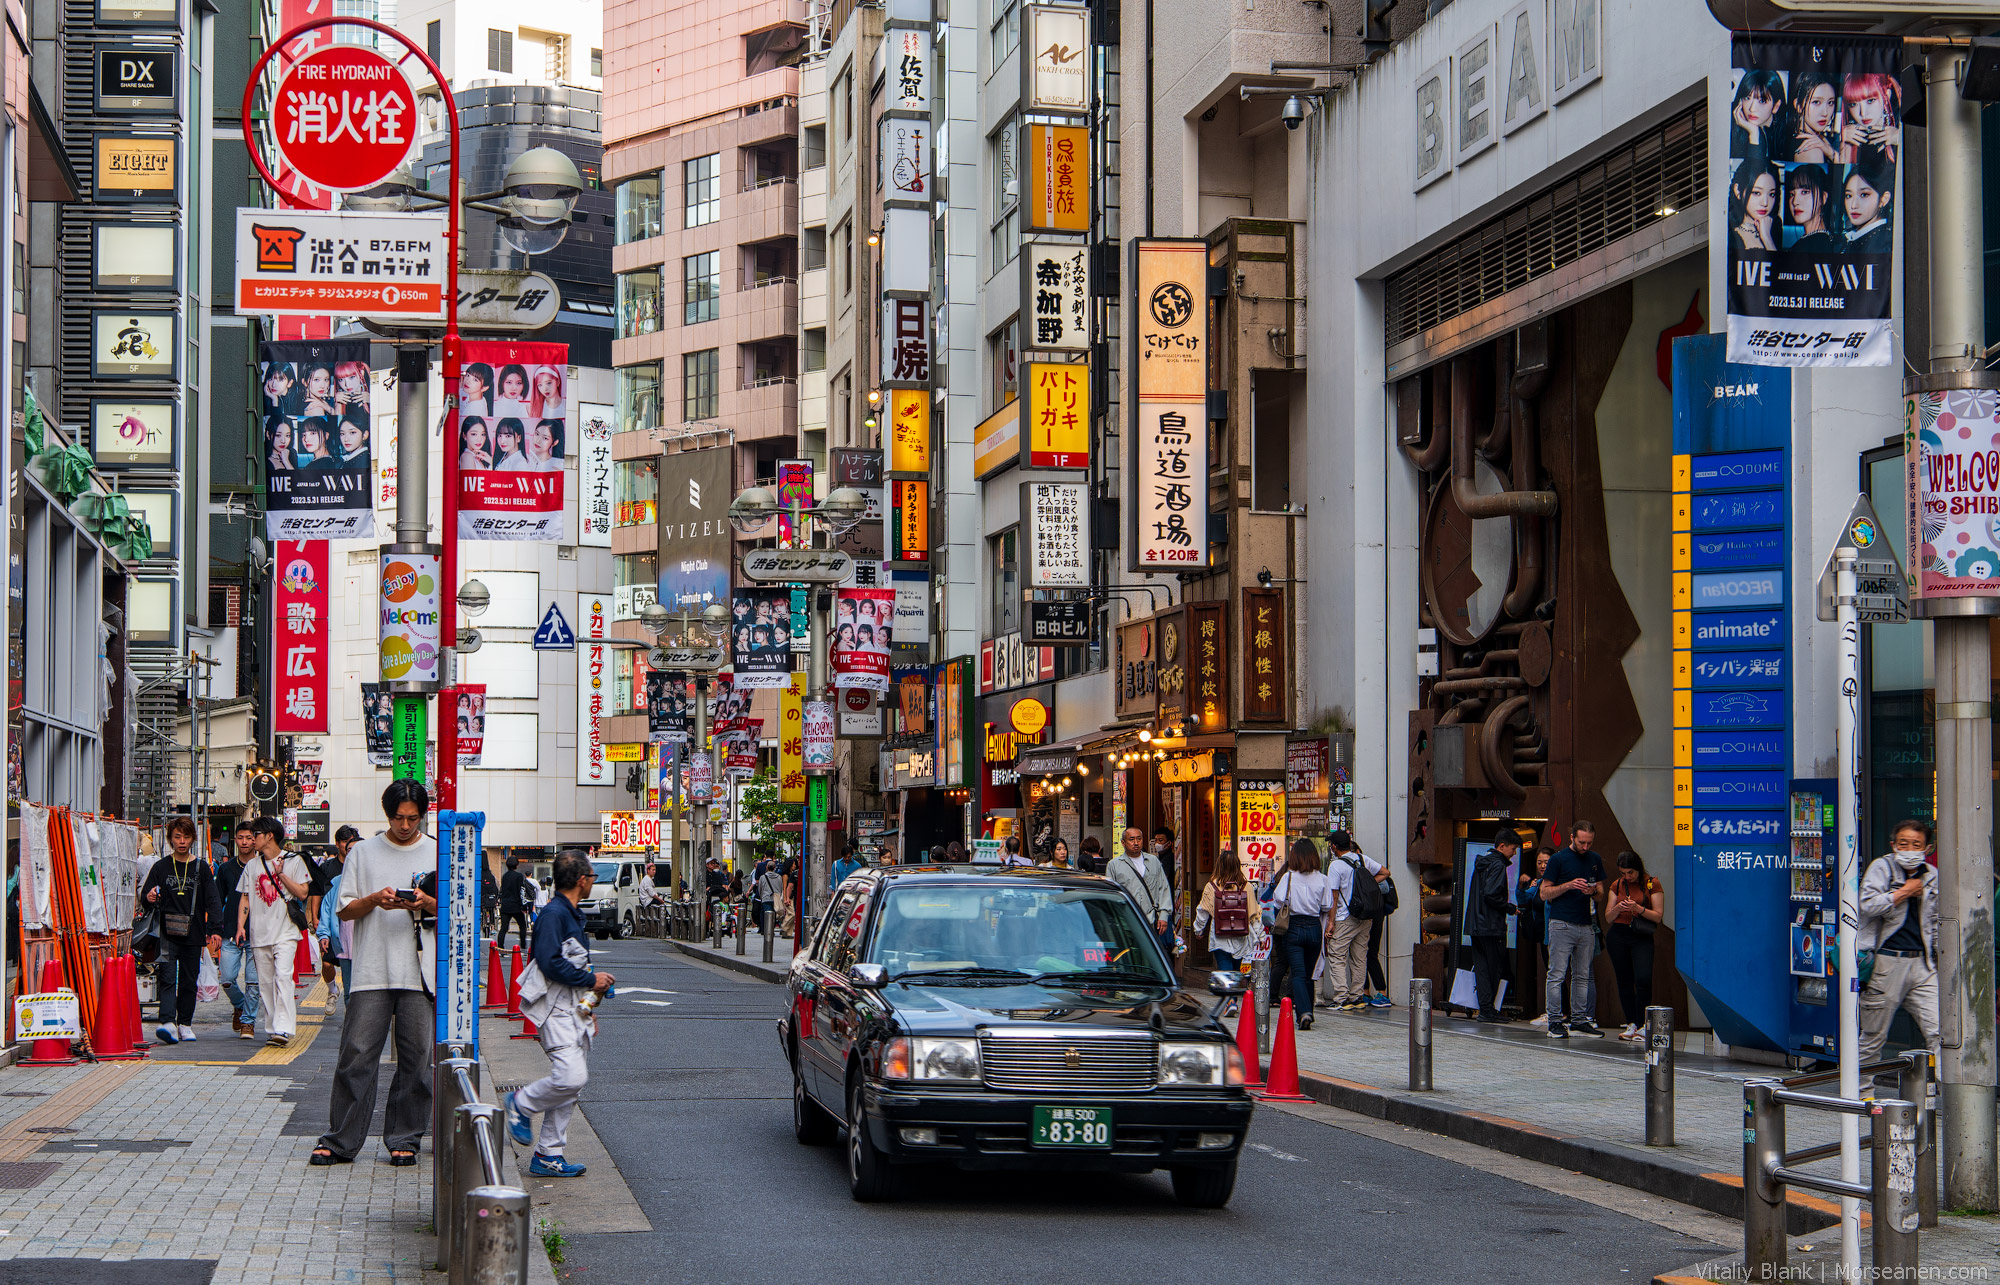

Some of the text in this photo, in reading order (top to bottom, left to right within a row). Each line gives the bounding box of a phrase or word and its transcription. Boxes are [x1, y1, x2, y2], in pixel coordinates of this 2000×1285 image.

[133, 11, 142, 19] 9F
[120, 61, 154, 82] DX
[298, 65, 393, 81] FIRE HYDRANT
[898, 54, 925, 101] 佐賀
[1059, 67, 1085, 75] CROSS
[1416, 0, 1596, 180] BEAM
[132, 99, 142, 107] 8F
[287, 90, 407, 145] 消火栓
[109, 153, 168, 171] EIGHT
[1056, 138, 1075, 215] 鳥貴族
[370, 240, 432, 252] 87.6FM
[310, 239, 432, 276] 渋谷のラジオ
[131, 276, 141, 284] 6F
[1063, 261, 1072, 289] なかの
[1737, 260, 1772, 287] IVE
[255, 286, 288, 298] ヒカリエ
[289, 286, 316, 298] デッキ
[401, 289, 429, 300] 650m
[1036, 258, 1064, 345] 奈加野
[1769, 296, 1845, 309] 2023.5.31 RELEASE
[893, 300, 929, 380] 日焼
[1144, 333, 1200, 350] てけてけ
[1747, 329, 1867, 348] 渋谷センター街
[1714, 383, 1759, 398] BEAM
[1061, 371, 1079, 431] トリキ
[1040, 371, 1059, 448] バーガー
[1053, 454, 1069, 466] 1F
[849, 468, 874, 480] ビル
[1152, 411, 1192, 546] 鳥道酒場
[271, 476, 291, 492] IVE
[464, 476, 485, 492] IVE
[592, 446, 610, 534] サウナ道場
[1037, 484, 1078, 497] 地下だけ
[291, 495, 345, 505] 2023.5.31 RELEASE
[484, 497, 537, 506] 2023.5.31 RELEASE
[1925, 496, 2000, 515] TO SHIB
[1037, 506, 1078, 515] 雰囲気良く
[1731, 500, 1776, 517] 鍋ぞう
[280, 516, 359, 529] 渋谷センター街
[472, 518, 549, 530] 渋谷センター街
[1037, 515, 1079, 523] て料理人が
[665, 519, 725, 540] VIZEL
[1037, 524, 1079, 532] しっかり食
[1037, 532, 1079, 541] 事を作って
[1038, 541, 1079, 550] お酒もたく
[1038, 550, 1079, 558] さんあって
[1145, 549, 1199, 561] 全120席
[681, 560, 708, 573] Night Club
[750, 558, 847, 571] 渋谷センター街
[1038, 558, 1083, 568] 楽しいお店。
[383, 571, 415, 597] Enjoy
[1926, 583, 1975, 591] SHIBUYA
[380, 607, 438, 625] Welcome
[895, 608, 925, 617] Aquavit
[1035, 620, 1087, 637] 田中ビル
[286, 601, 316, 720] 歌広場
[399, 650, 420, 664] Lovely
[737, 654, 749, 663] IVE
[840, 655, 851, 664] IVE
[1254, 606, 1273, 702] ど根性串
[1200, 619, 1217, 716] 博多水炊き
[1696, 658, 1781, 677] イシバシ楽器
[848, 696, 868, 705] ガスト
[590, 693, 604, 780] まねきねこ
[804, 721, 833, 736] WELCOME
[404, 702, 418, 779] 客引きは犯罪です
[1748, 743, 1781, 752] HALL
[1748, 782, 1781, 792] HALL
[1240, 801, 1271, 811] 生ビール
[1241, 811, 1276, 832] 180
[1710, 819, 1780, 834] まんだらけ
[611, 820, 629, 845] 50
[629, 822, 637, 844] 生中
[637, 819, 660, 846] 190
[1247, 842, 1277, 861] 99
[1717, 851, 1788, 869] 銀行ATM
[1074, 1109, 1096, 1120] 500
[1049, 1121, 1108, 1143] 83-80
